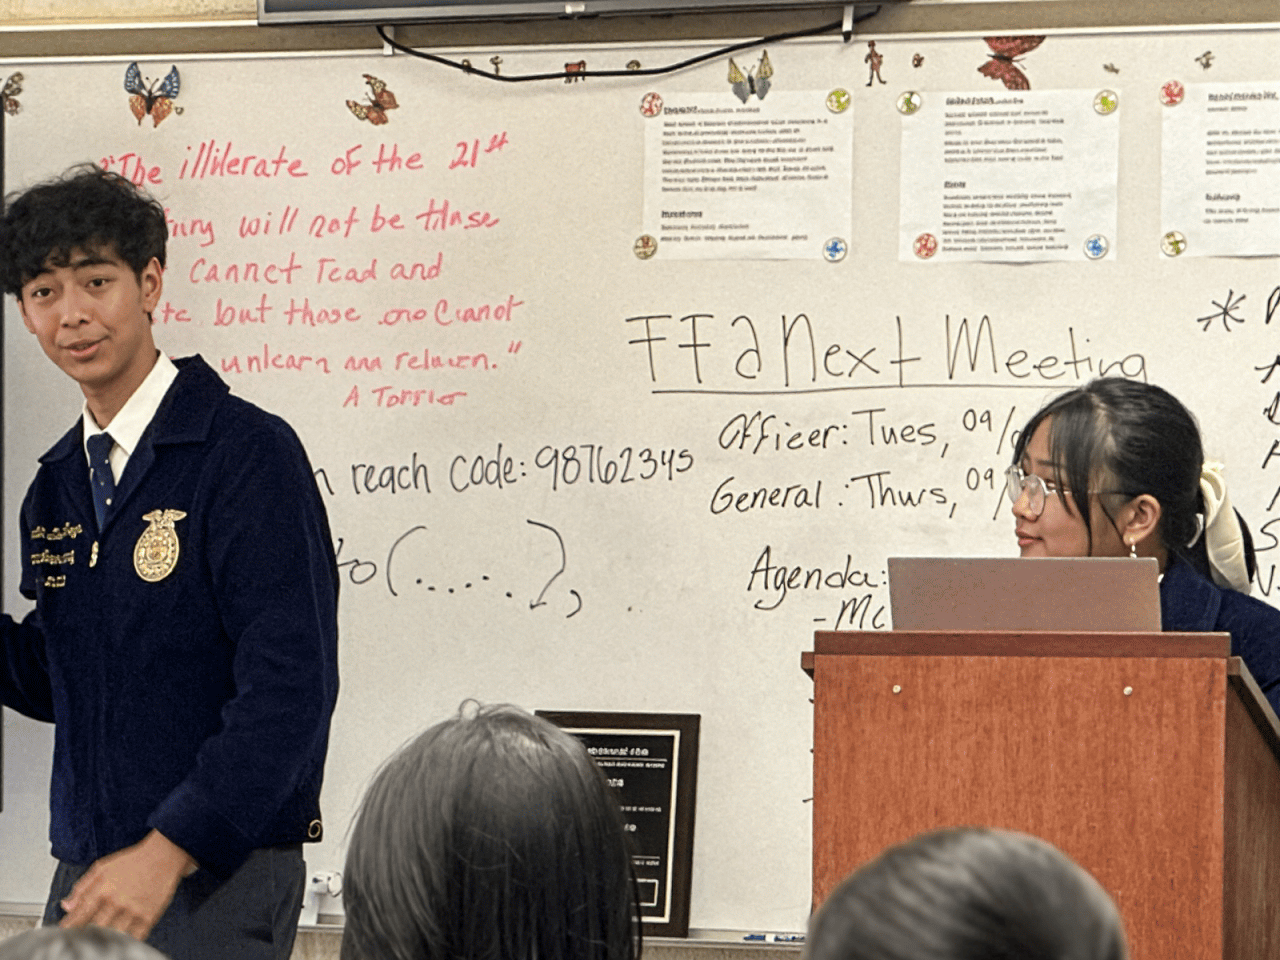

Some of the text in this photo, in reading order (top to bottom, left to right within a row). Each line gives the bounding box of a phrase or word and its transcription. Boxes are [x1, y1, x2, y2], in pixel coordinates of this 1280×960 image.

[331, 144, 362, 175] of
[372, 143, 424, 173] the
[238, 205, 299, 239] will
[370, 204, 405, 232] be
[390, 252, 443, 280] and
[351, 451, 432, 495] reach
[746, 544, 888, 611] Agenda:
